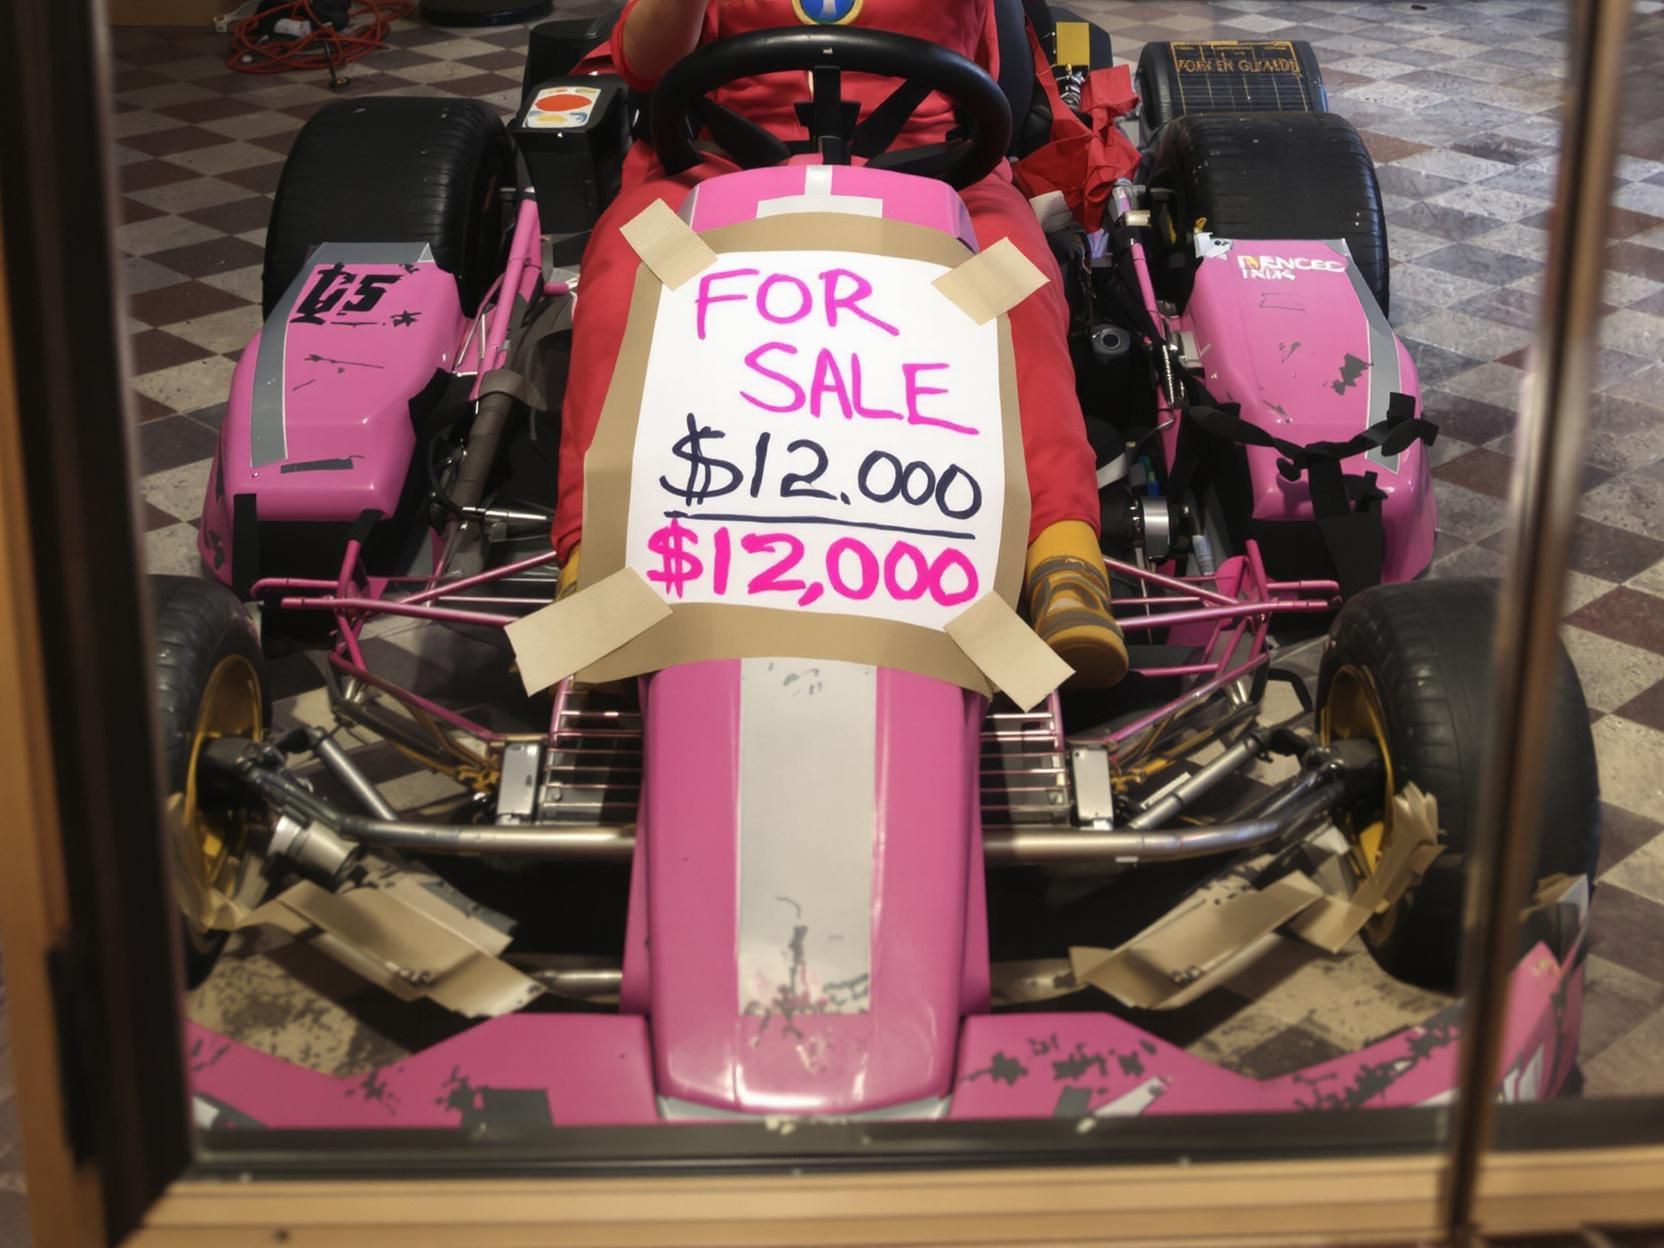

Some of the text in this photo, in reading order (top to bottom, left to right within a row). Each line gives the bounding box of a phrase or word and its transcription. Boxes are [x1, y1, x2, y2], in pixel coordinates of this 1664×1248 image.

[695, 268, 900, 340] FOR
[739, 341, 980, 435] SALE
[659, 412, 982, 520] $12.000
[647, 518, 979, 607] $12,000
